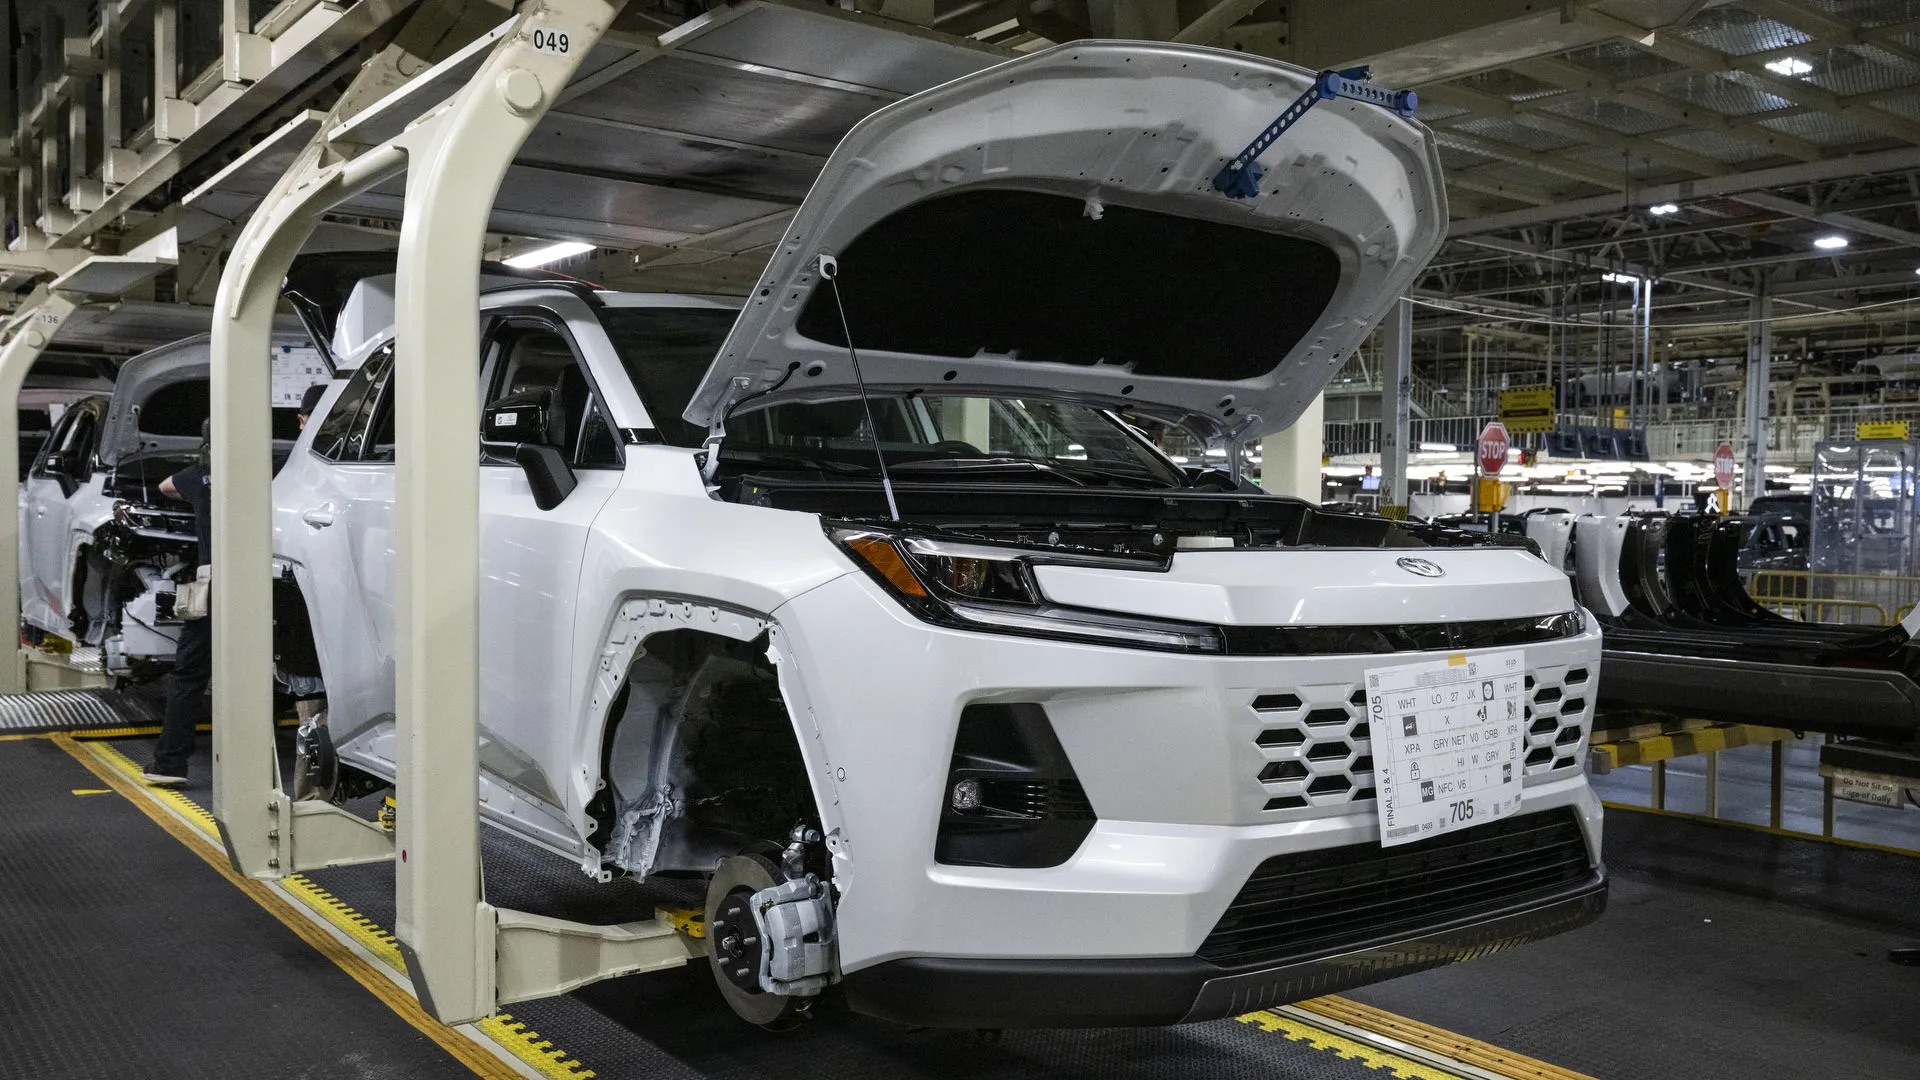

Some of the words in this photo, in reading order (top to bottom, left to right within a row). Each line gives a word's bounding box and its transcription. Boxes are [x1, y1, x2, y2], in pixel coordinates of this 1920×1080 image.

[533, 29, 569, 53] 049
[42, 314, 59, 324] 136
[1481, 440, 1505, 460] STOP
[1397, 697, 1417, 710] WHT
[1450, 691, 1459, 702] 27
[1466, 689, 1476, 700] JX
[1503, 681, 1518, 693] WHT
[1371, 695, 1384, 723] 705
[1444, 715, 1450, 725] X
[1404, 743, 1422, 755] XPA
[1433, 738, 1449, 750] GRY
[1451, 734, 1466, 747] NET
[1484, 728, 1499, 740] CRB
[1506, 724, 1518, 735] XPA
[1457, 757, 1465, 768] HI
[1471, 754, 1479, 764] W
[1485, 750, 1500, 762] GRY
[1421, 786, 1434, 797] MG
[1437, 782, 1453, 795] NFC
[1457, 779, 1467, 790] V6
[1843, 777, 1854, 786] Do
[1855, 780, 1870, 788] Not
[1861, 791, 1871, 800] of
[1386, 796, 1395, 827] FINAL
[1449, 798, 1474, 824] 705
